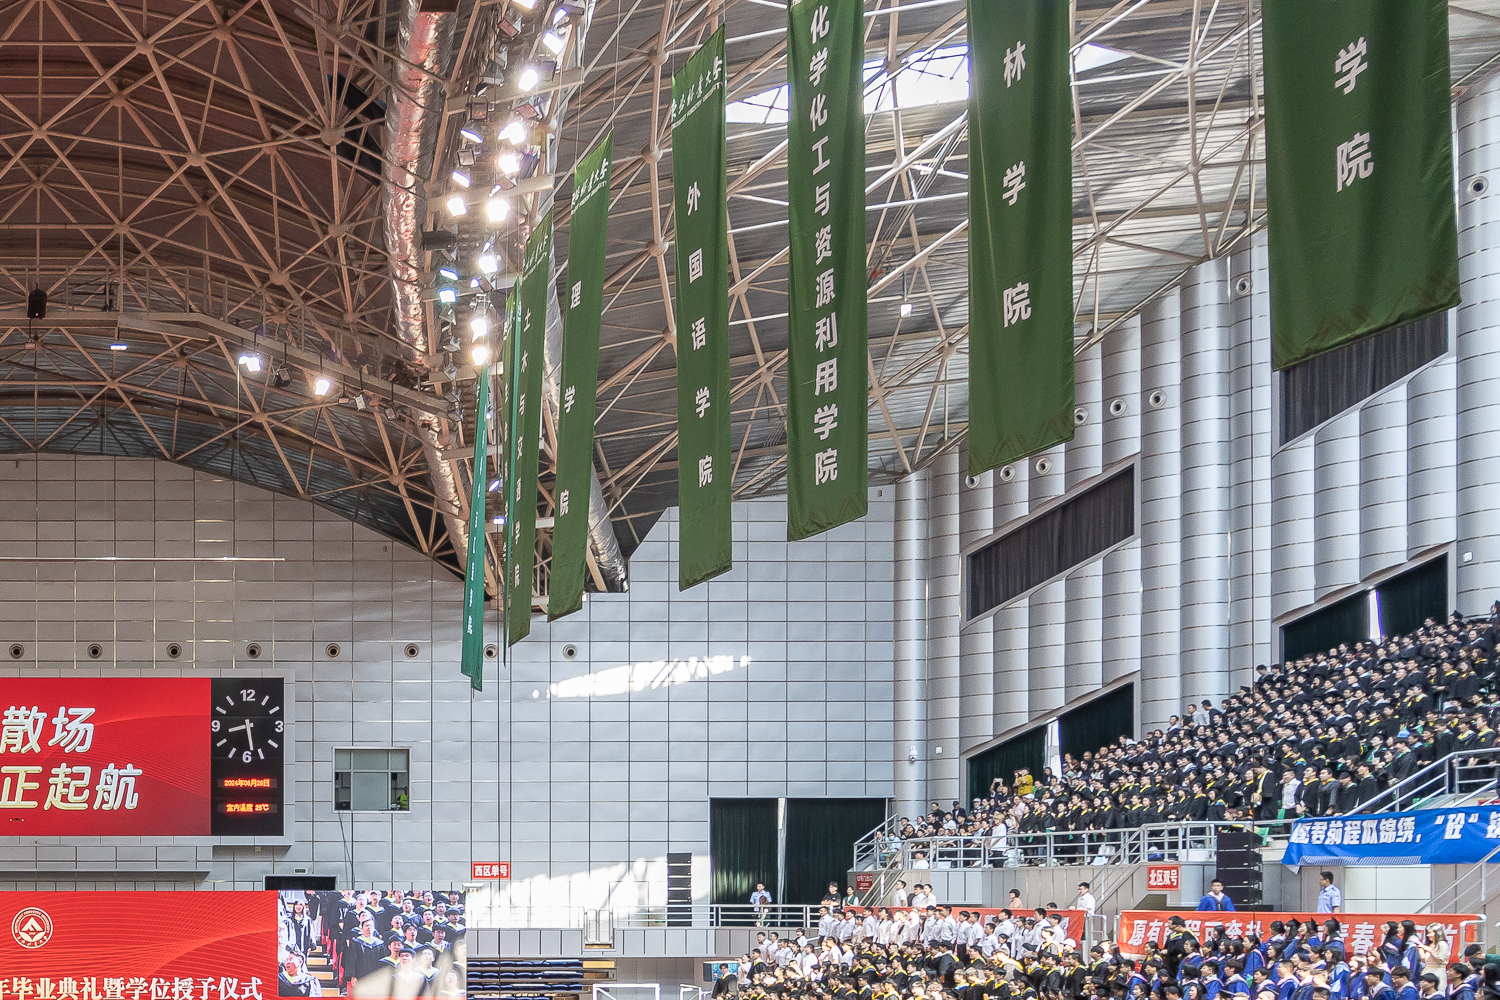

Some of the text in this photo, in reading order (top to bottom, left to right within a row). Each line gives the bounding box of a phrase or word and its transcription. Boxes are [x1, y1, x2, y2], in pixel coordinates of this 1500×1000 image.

[1334, 36, 1374, 193] 学院
[1002, 40, 1032, 328] 林学院
[809, 4, 839, 486] 化学化工与资源利用学院
[686, 181, 713, 488] 外国语学院
[559, 280, 582, 517] 理学院
[514, 307, 532, 588] 土木与交通学院
[211, 719, 221, 733] 9
[240, 689, 256, 702] 12
[274, 720, 285, 733] 3
[242, 750, 252, 763] 6
[474, 865, 509, 878] 西区单号
[1149, 868, 1179, 887] 北区双号
